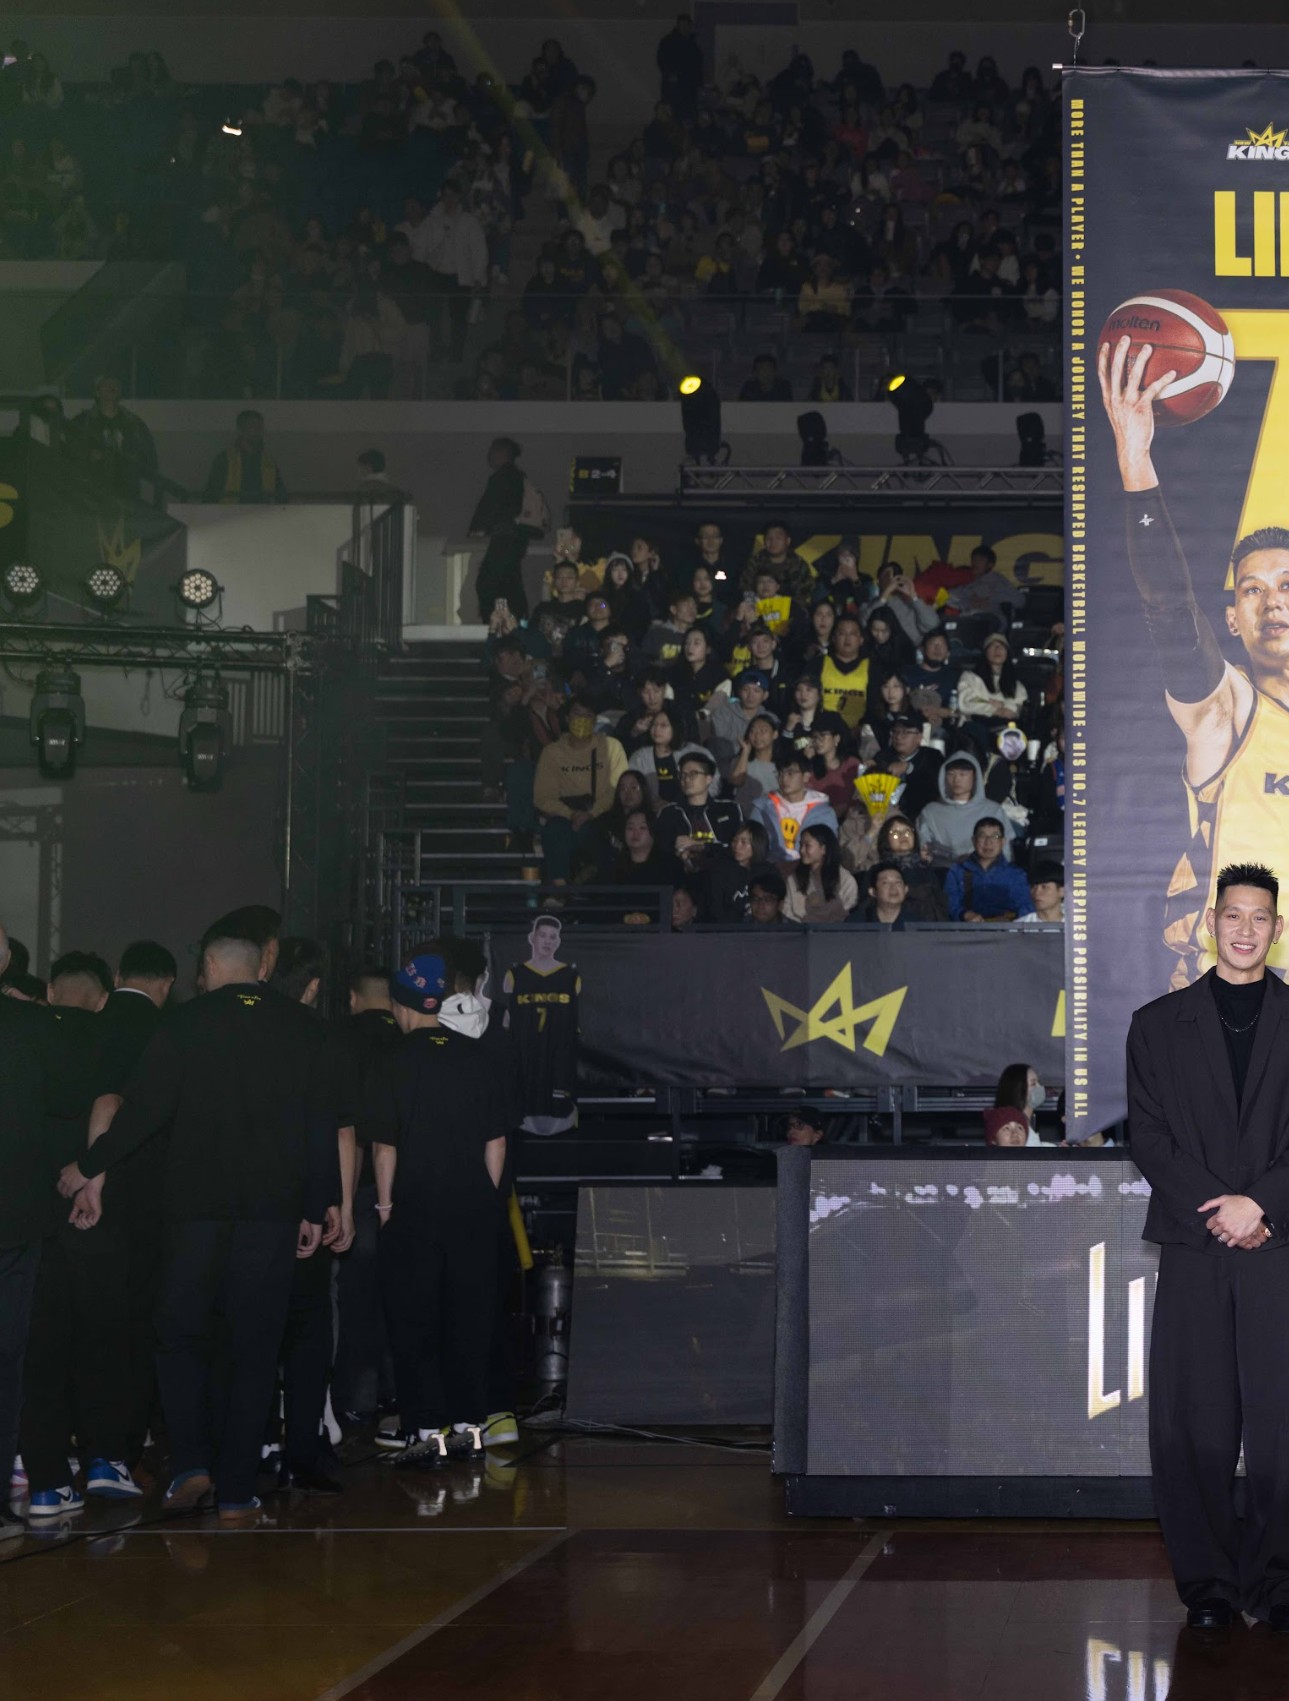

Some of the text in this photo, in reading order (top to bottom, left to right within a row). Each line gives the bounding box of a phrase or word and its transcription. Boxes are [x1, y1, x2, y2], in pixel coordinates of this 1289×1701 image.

[1109, 316, 1161, 331] molten
[1070, 98, 1088, 1118] MORE THAN A PLAYER WE HONOR A JOURNEY THAT RESHAPED BASKETBALL WORLDWIDE HIS NO.7 LEGACY INSPIRES POSSIBILITY IN US ALL
[517, 993, 570, 1005] KINGS
[536, 1007, 547, 1032] 7
